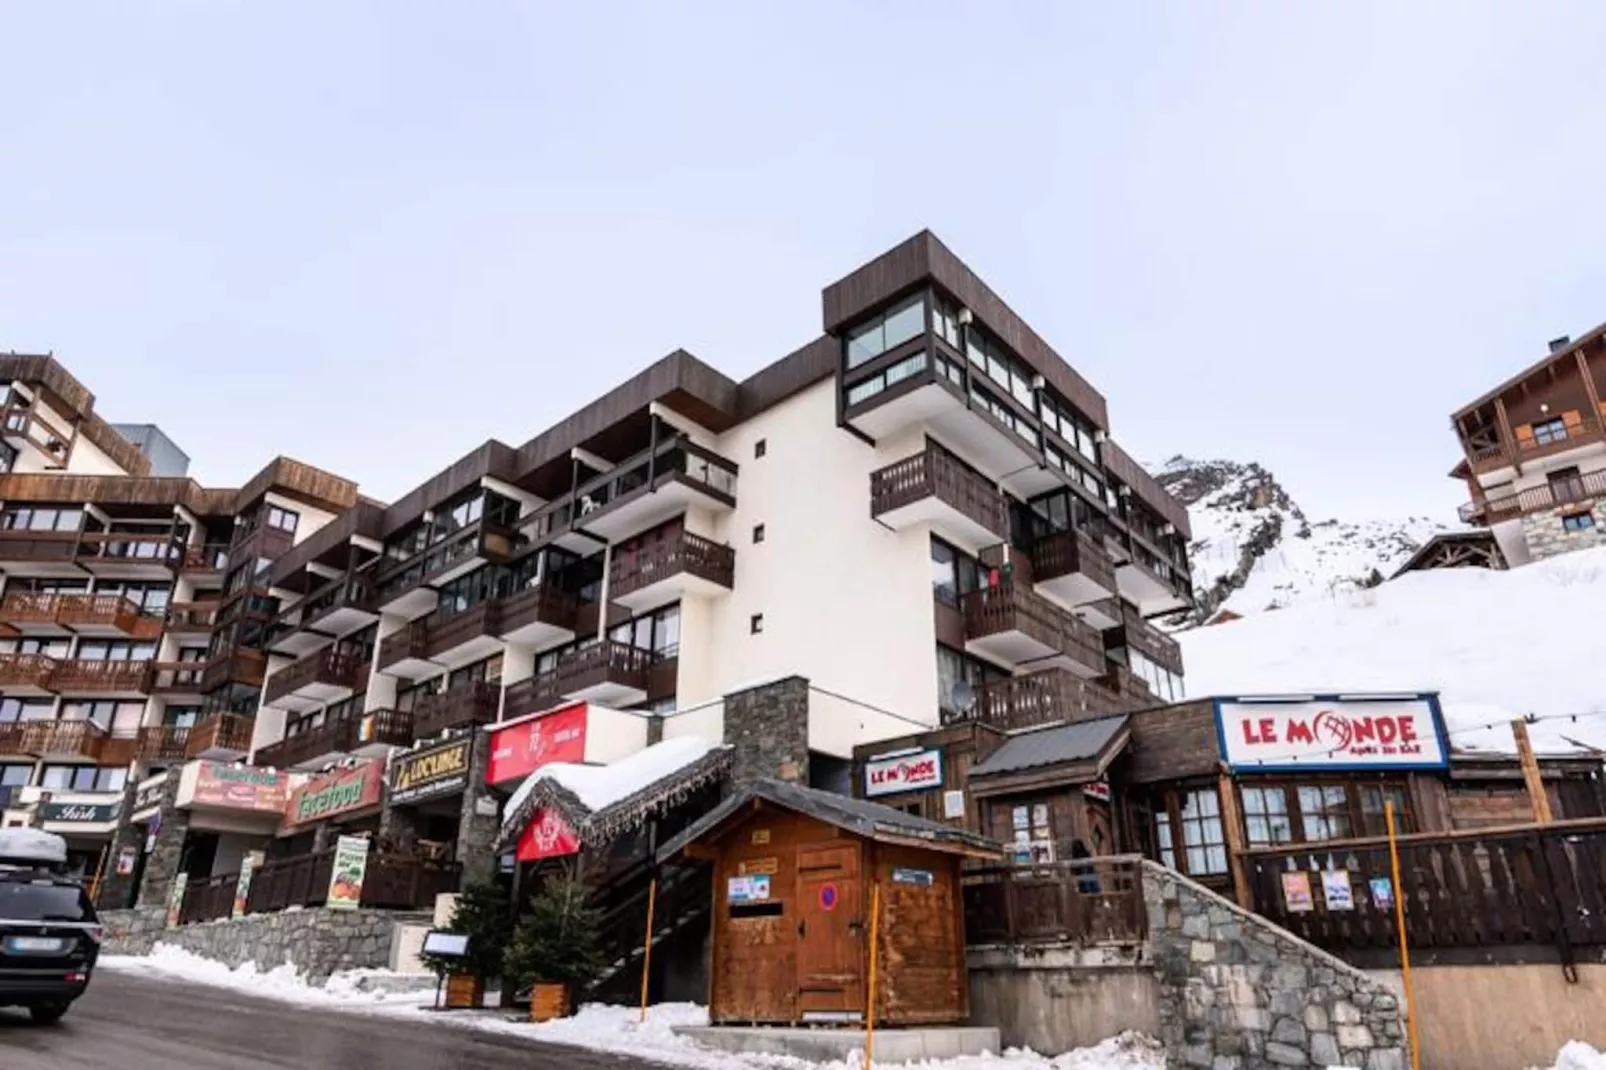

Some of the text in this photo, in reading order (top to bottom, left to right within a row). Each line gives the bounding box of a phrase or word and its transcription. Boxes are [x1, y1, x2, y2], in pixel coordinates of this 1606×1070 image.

[1242, 710, 1417, 751] LE MONDE
[871, 769, 885, 785] LE
[887, 760, 935, 783] MONDE
